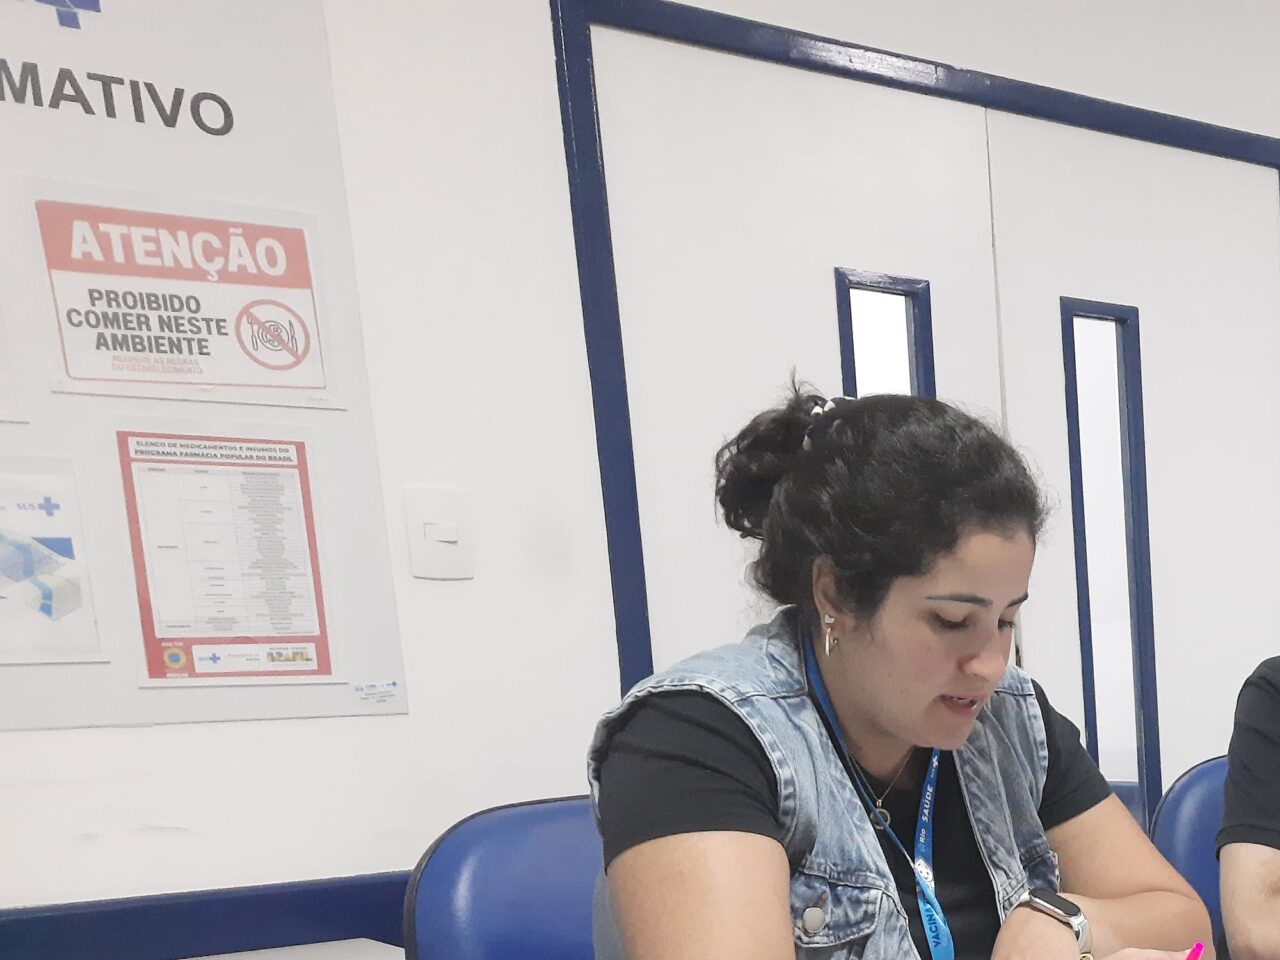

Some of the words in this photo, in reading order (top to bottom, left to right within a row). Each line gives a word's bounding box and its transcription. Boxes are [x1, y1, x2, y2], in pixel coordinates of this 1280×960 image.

[70, 219, 288, 282] ATENÇÃO
[88, 288, 201, 314] PROIBIDO
[66, 308, 152, 332] COMER
[158, 315, 229, 336] NESTE
[95, 332, 211, 356] AMBIENTE
